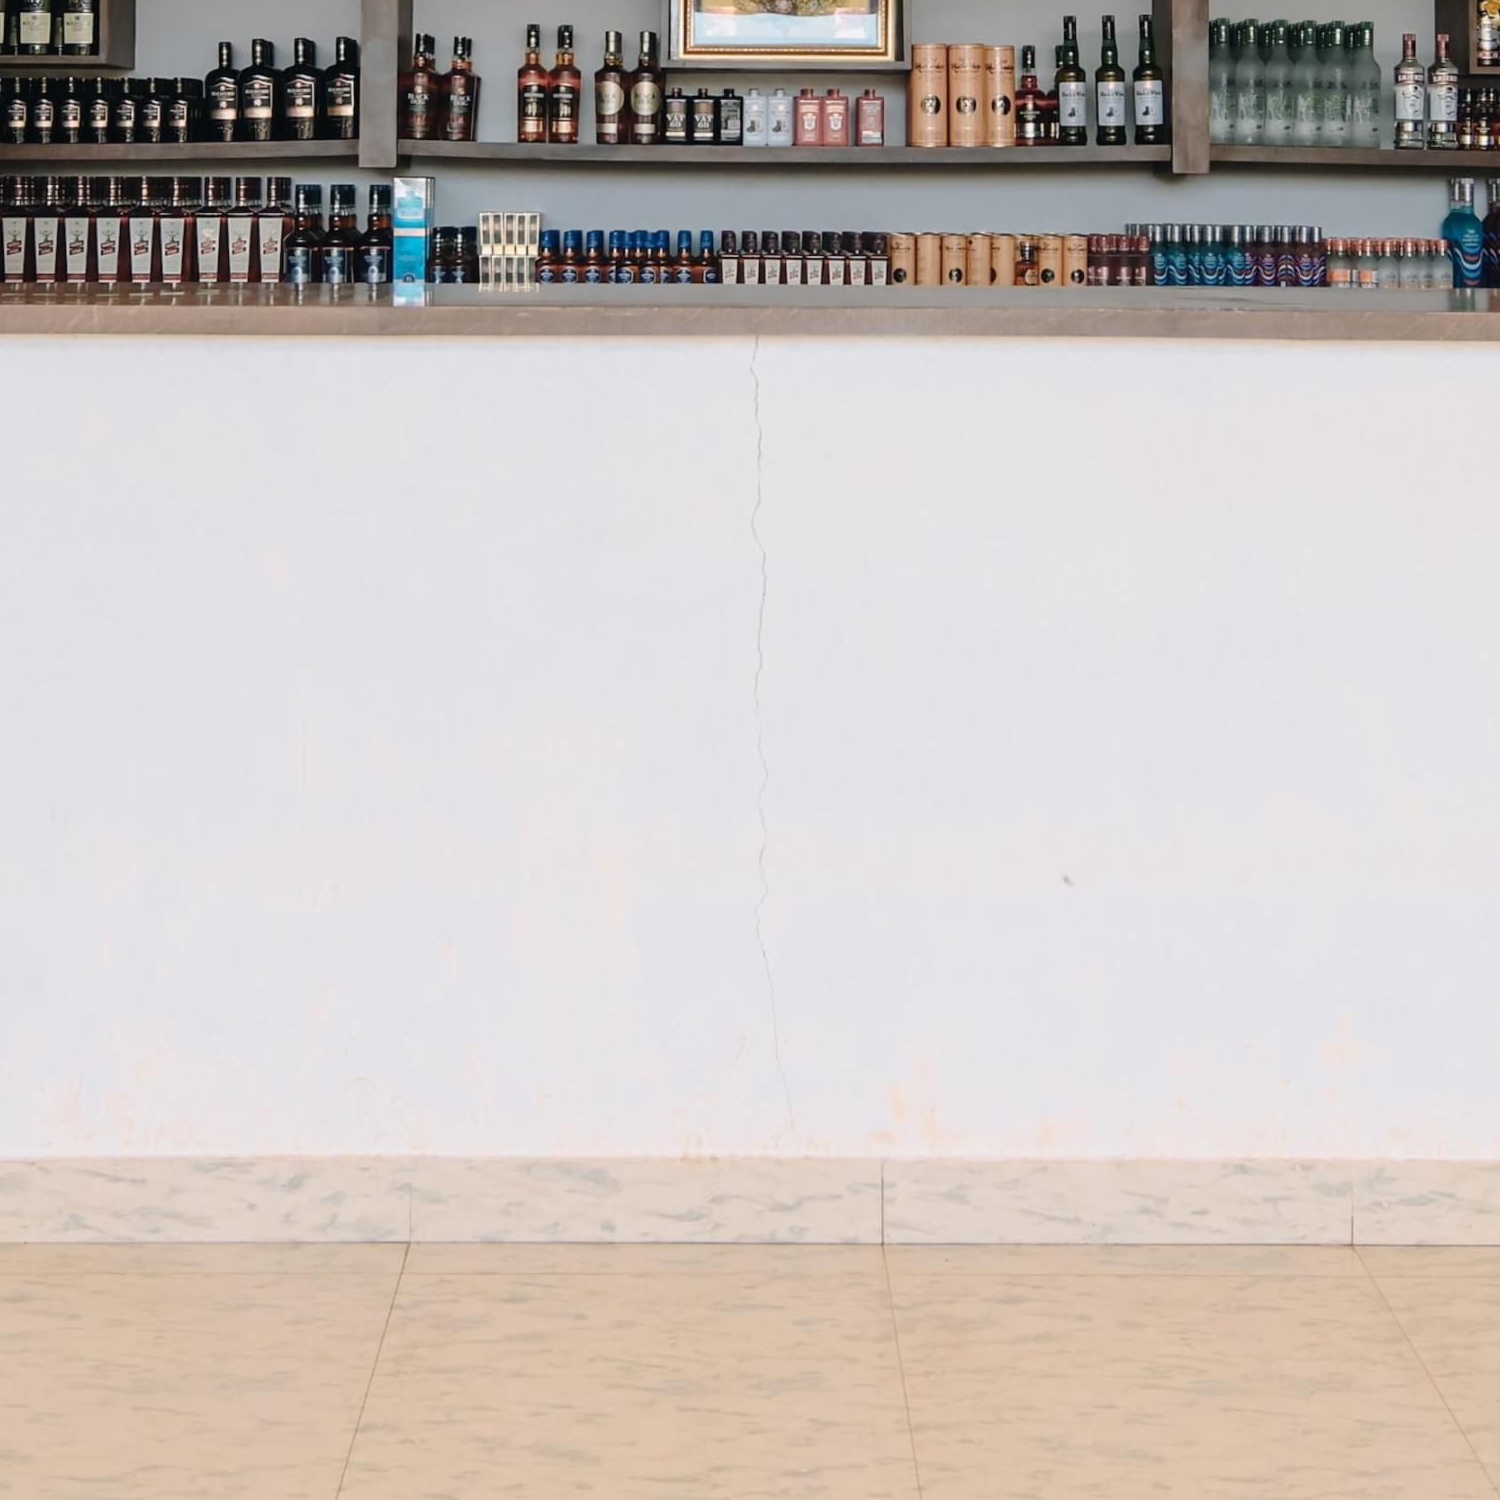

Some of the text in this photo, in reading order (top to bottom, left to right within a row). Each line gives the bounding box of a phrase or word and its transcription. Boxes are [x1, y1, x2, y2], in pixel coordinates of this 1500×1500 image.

[408, 92, 430, 100] BLACK
[666, 114, 687, 122] VAT
[694, 114, 713, 122] VAT
